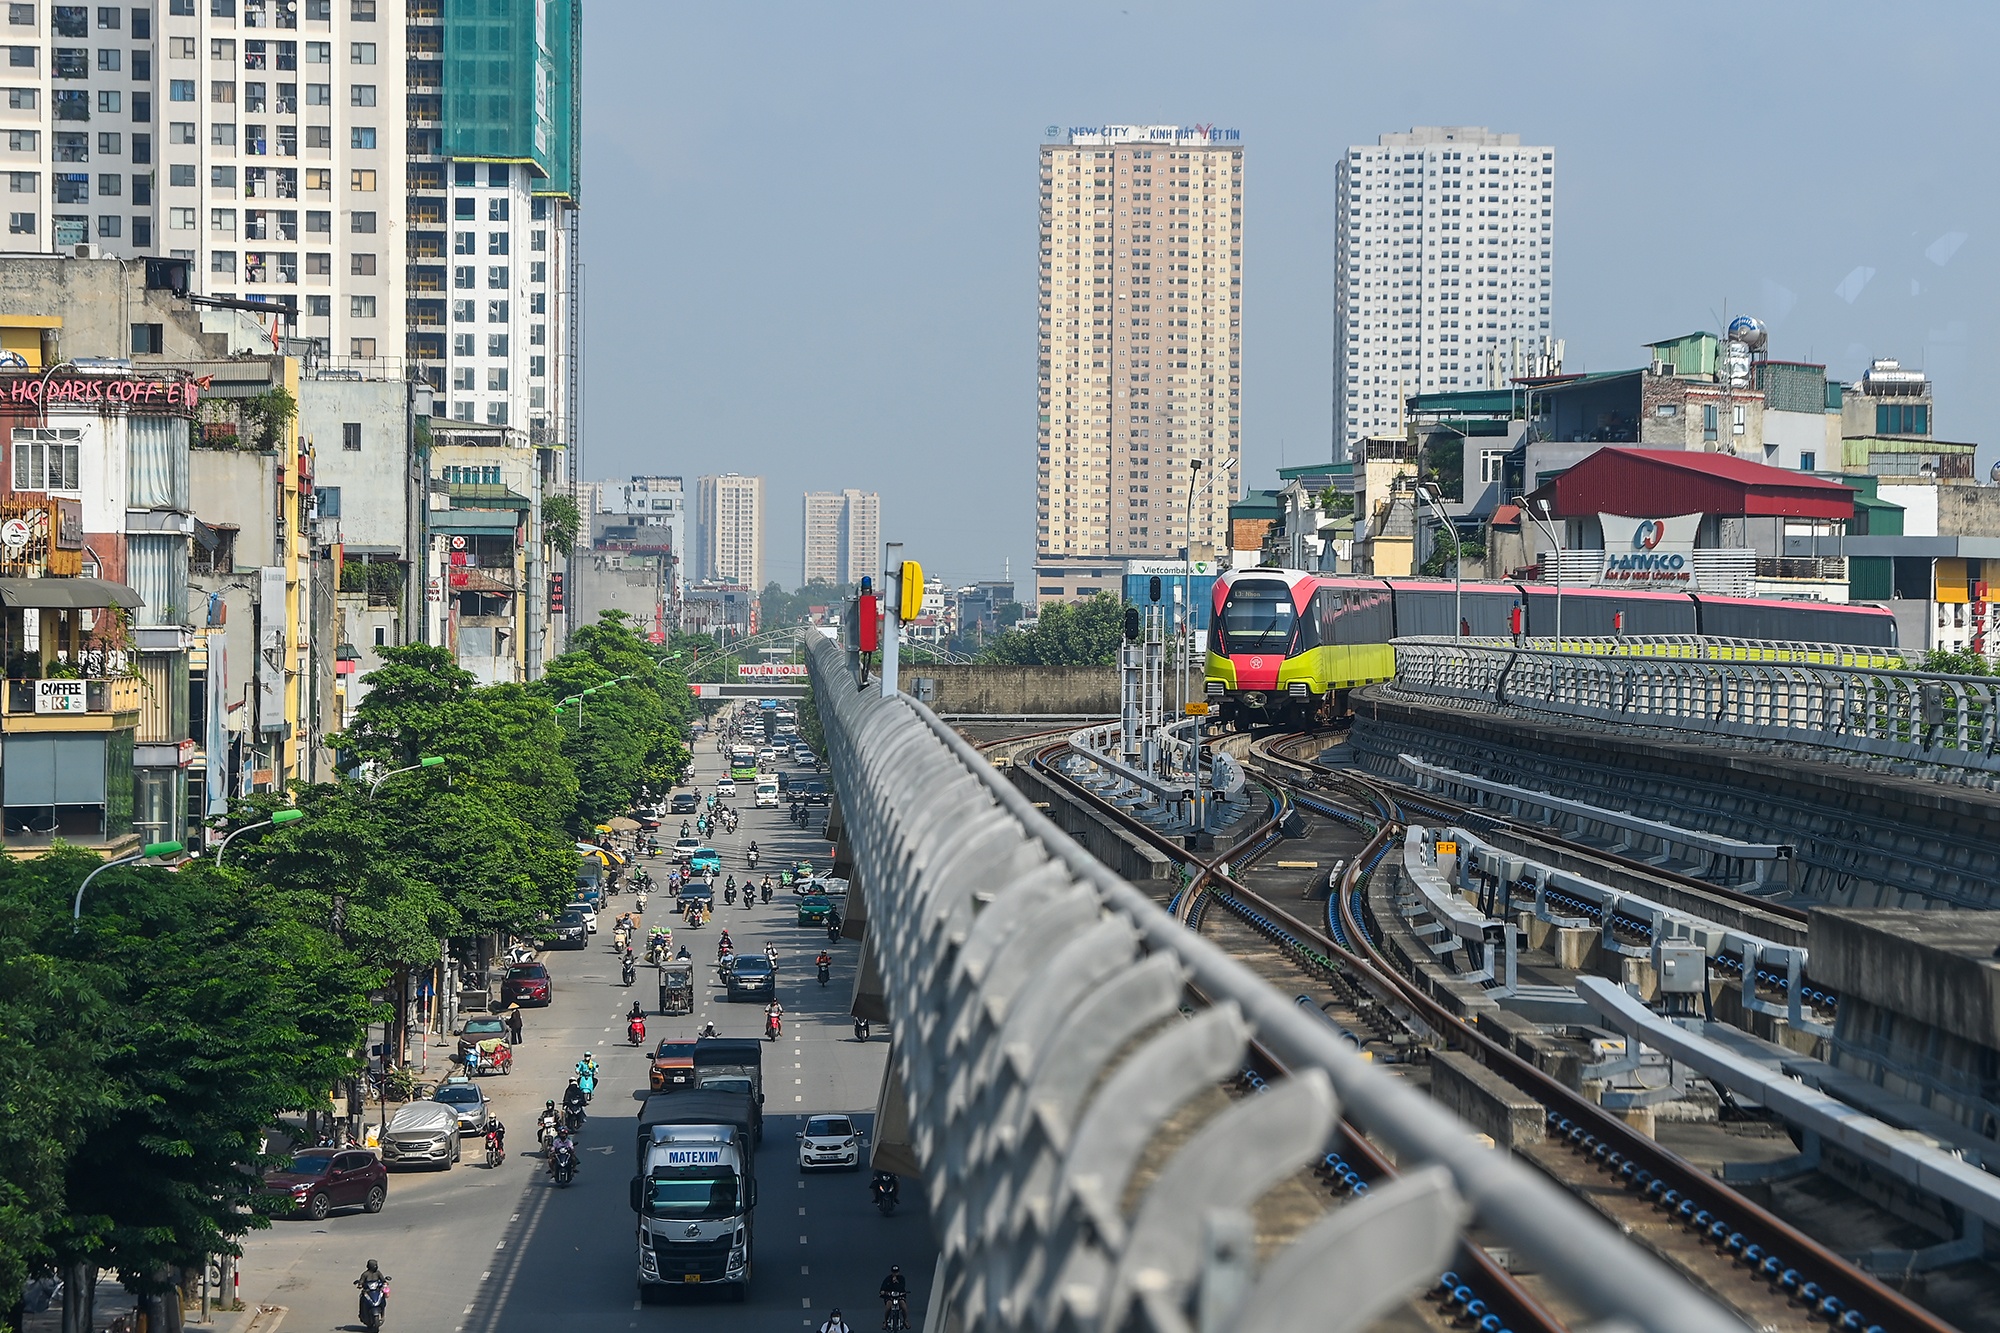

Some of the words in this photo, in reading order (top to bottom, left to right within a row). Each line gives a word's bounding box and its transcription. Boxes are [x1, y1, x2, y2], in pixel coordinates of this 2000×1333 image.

[1069, 127, 1097, 136] NEW
[1101, 127, 1129, 137] CITY
[47, 380, 102, 403] PARIS
[1142, 566, 1195, 574] Vietcombak
[740, 665, 773, 676] HUYỆN
[41, 682, 82, 696] COFFEE
[1438, 844, 1455, 852] FP
[669, 1151, 719, 1164] MATEXIM
